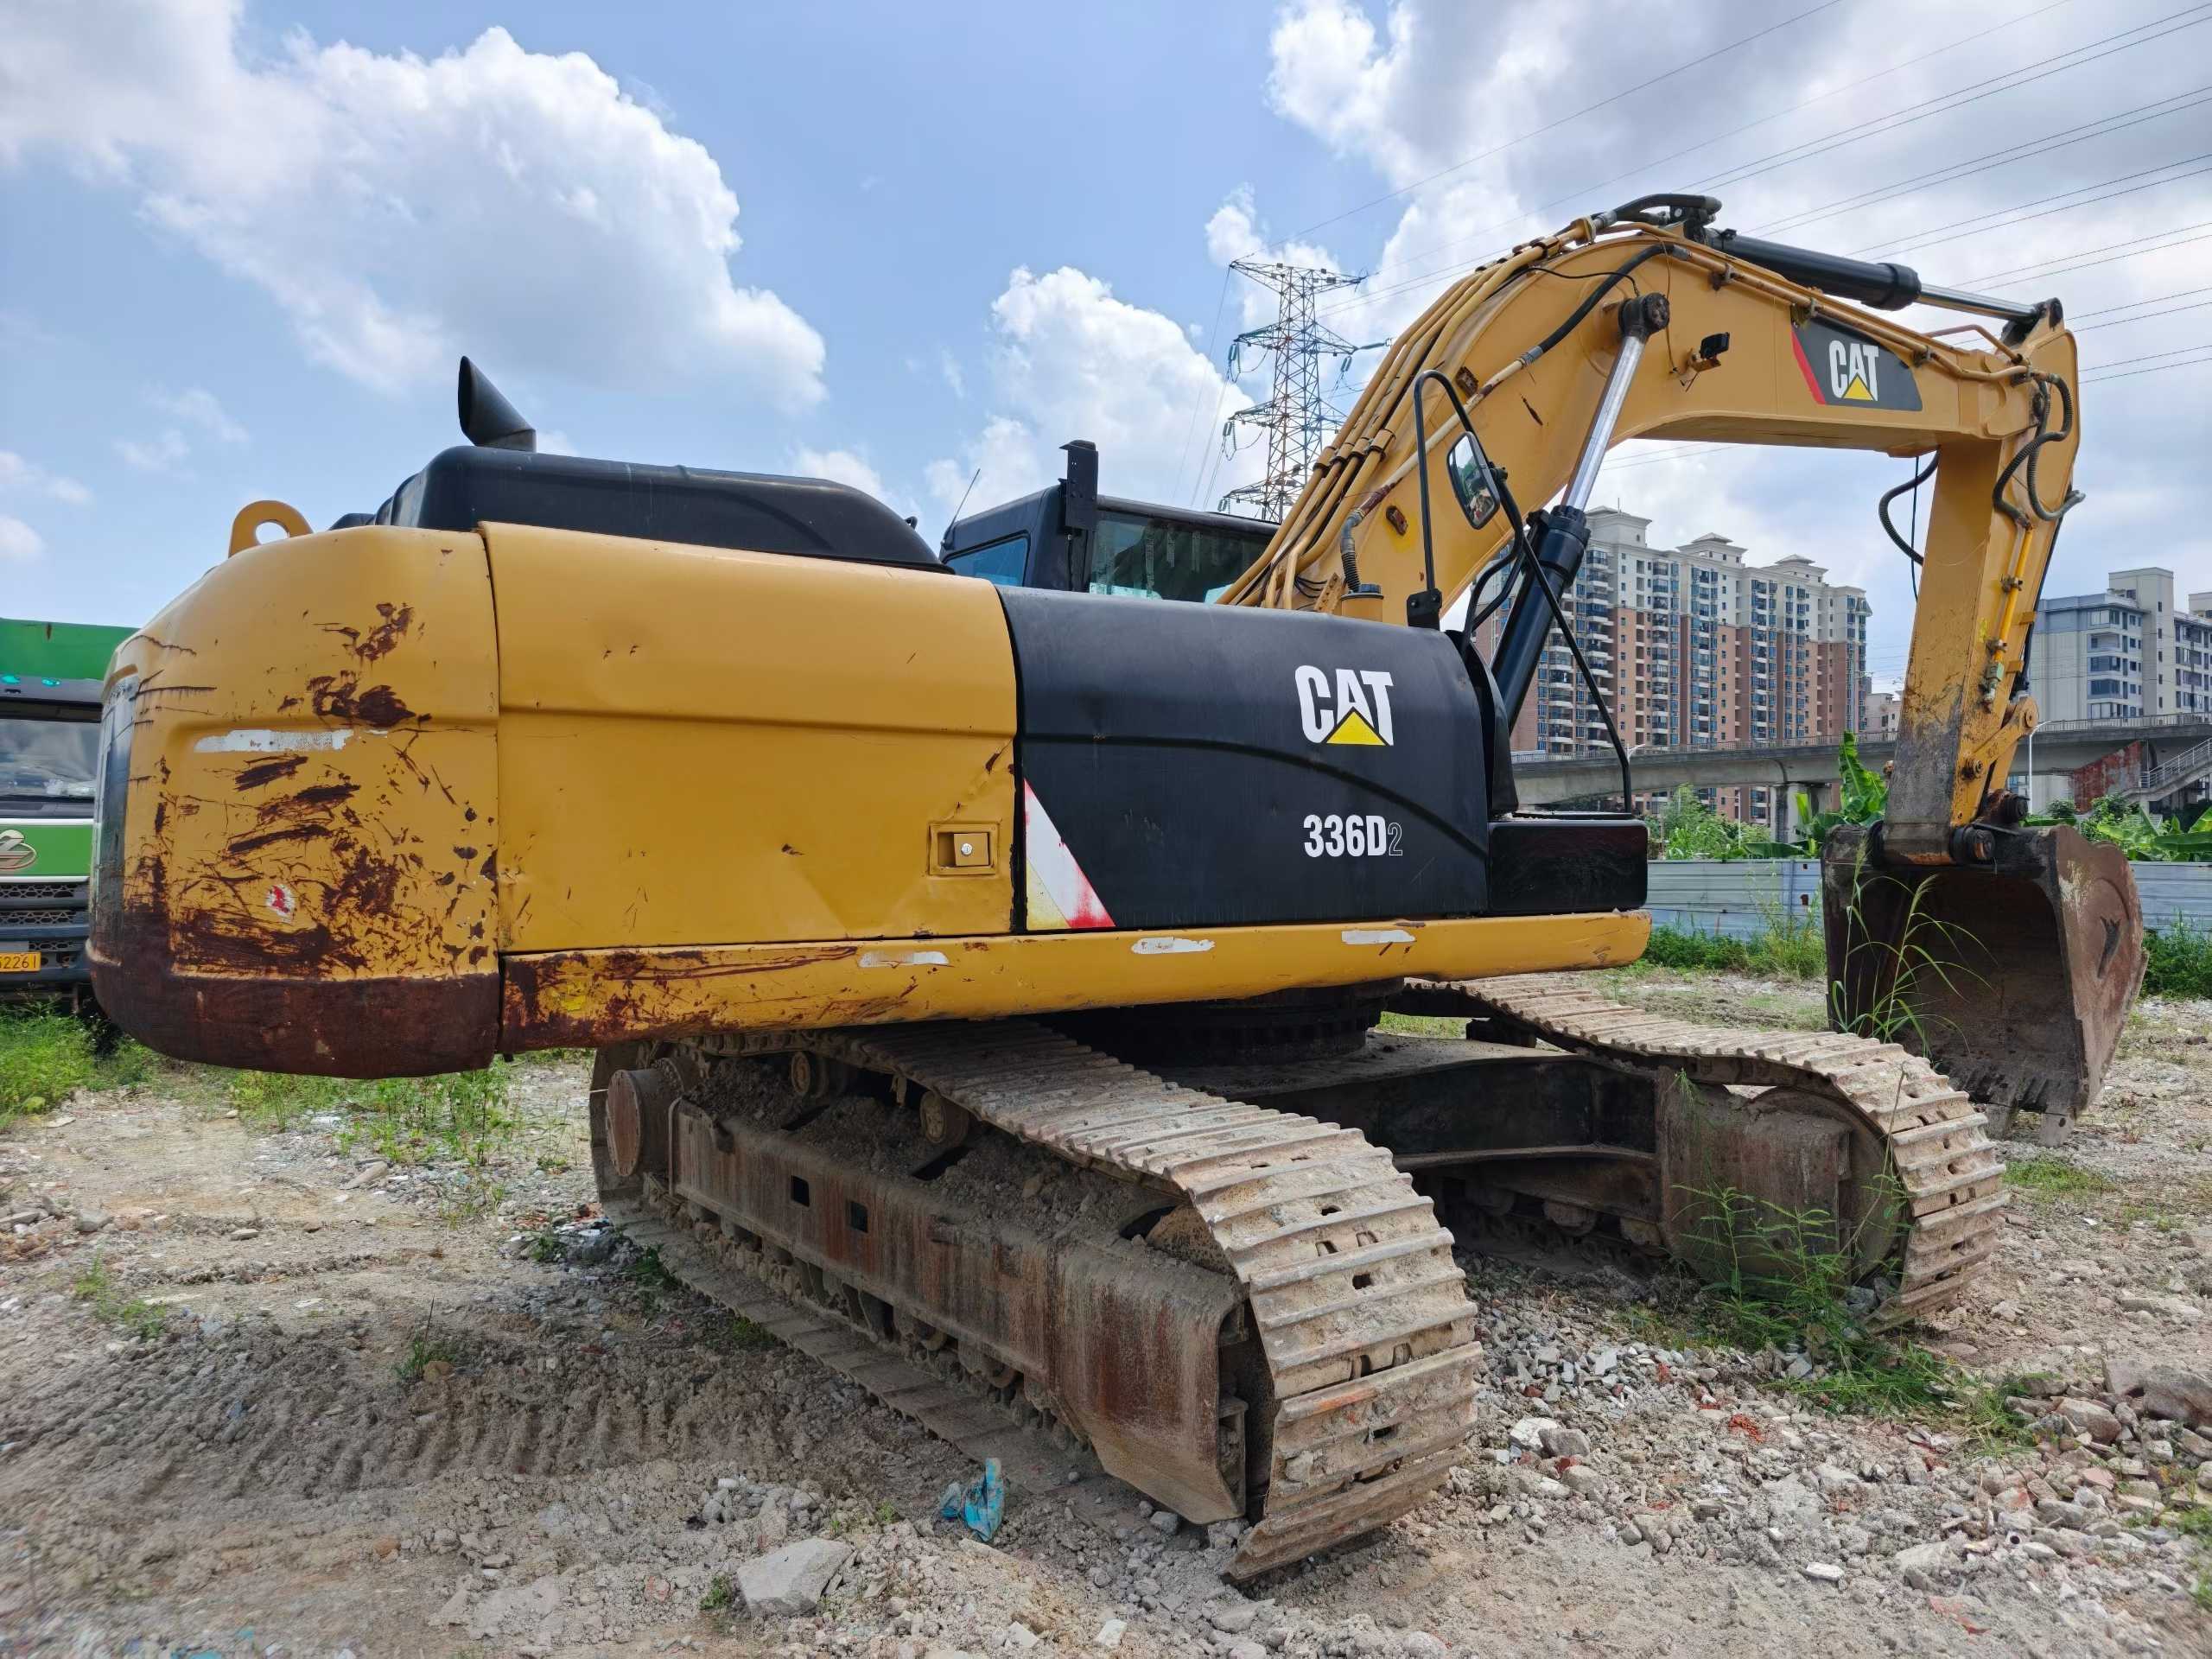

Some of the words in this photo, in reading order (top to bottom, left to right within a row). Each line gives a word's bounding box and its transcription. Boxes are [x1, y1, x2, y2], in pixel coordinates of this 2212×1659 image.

[1829, 340, 1878, 402] CAT
[1294, 664, 1394, 746] CAT
[1303, 814, 1403, 858] 336D2
[0, 954, 36, 969] 2261
